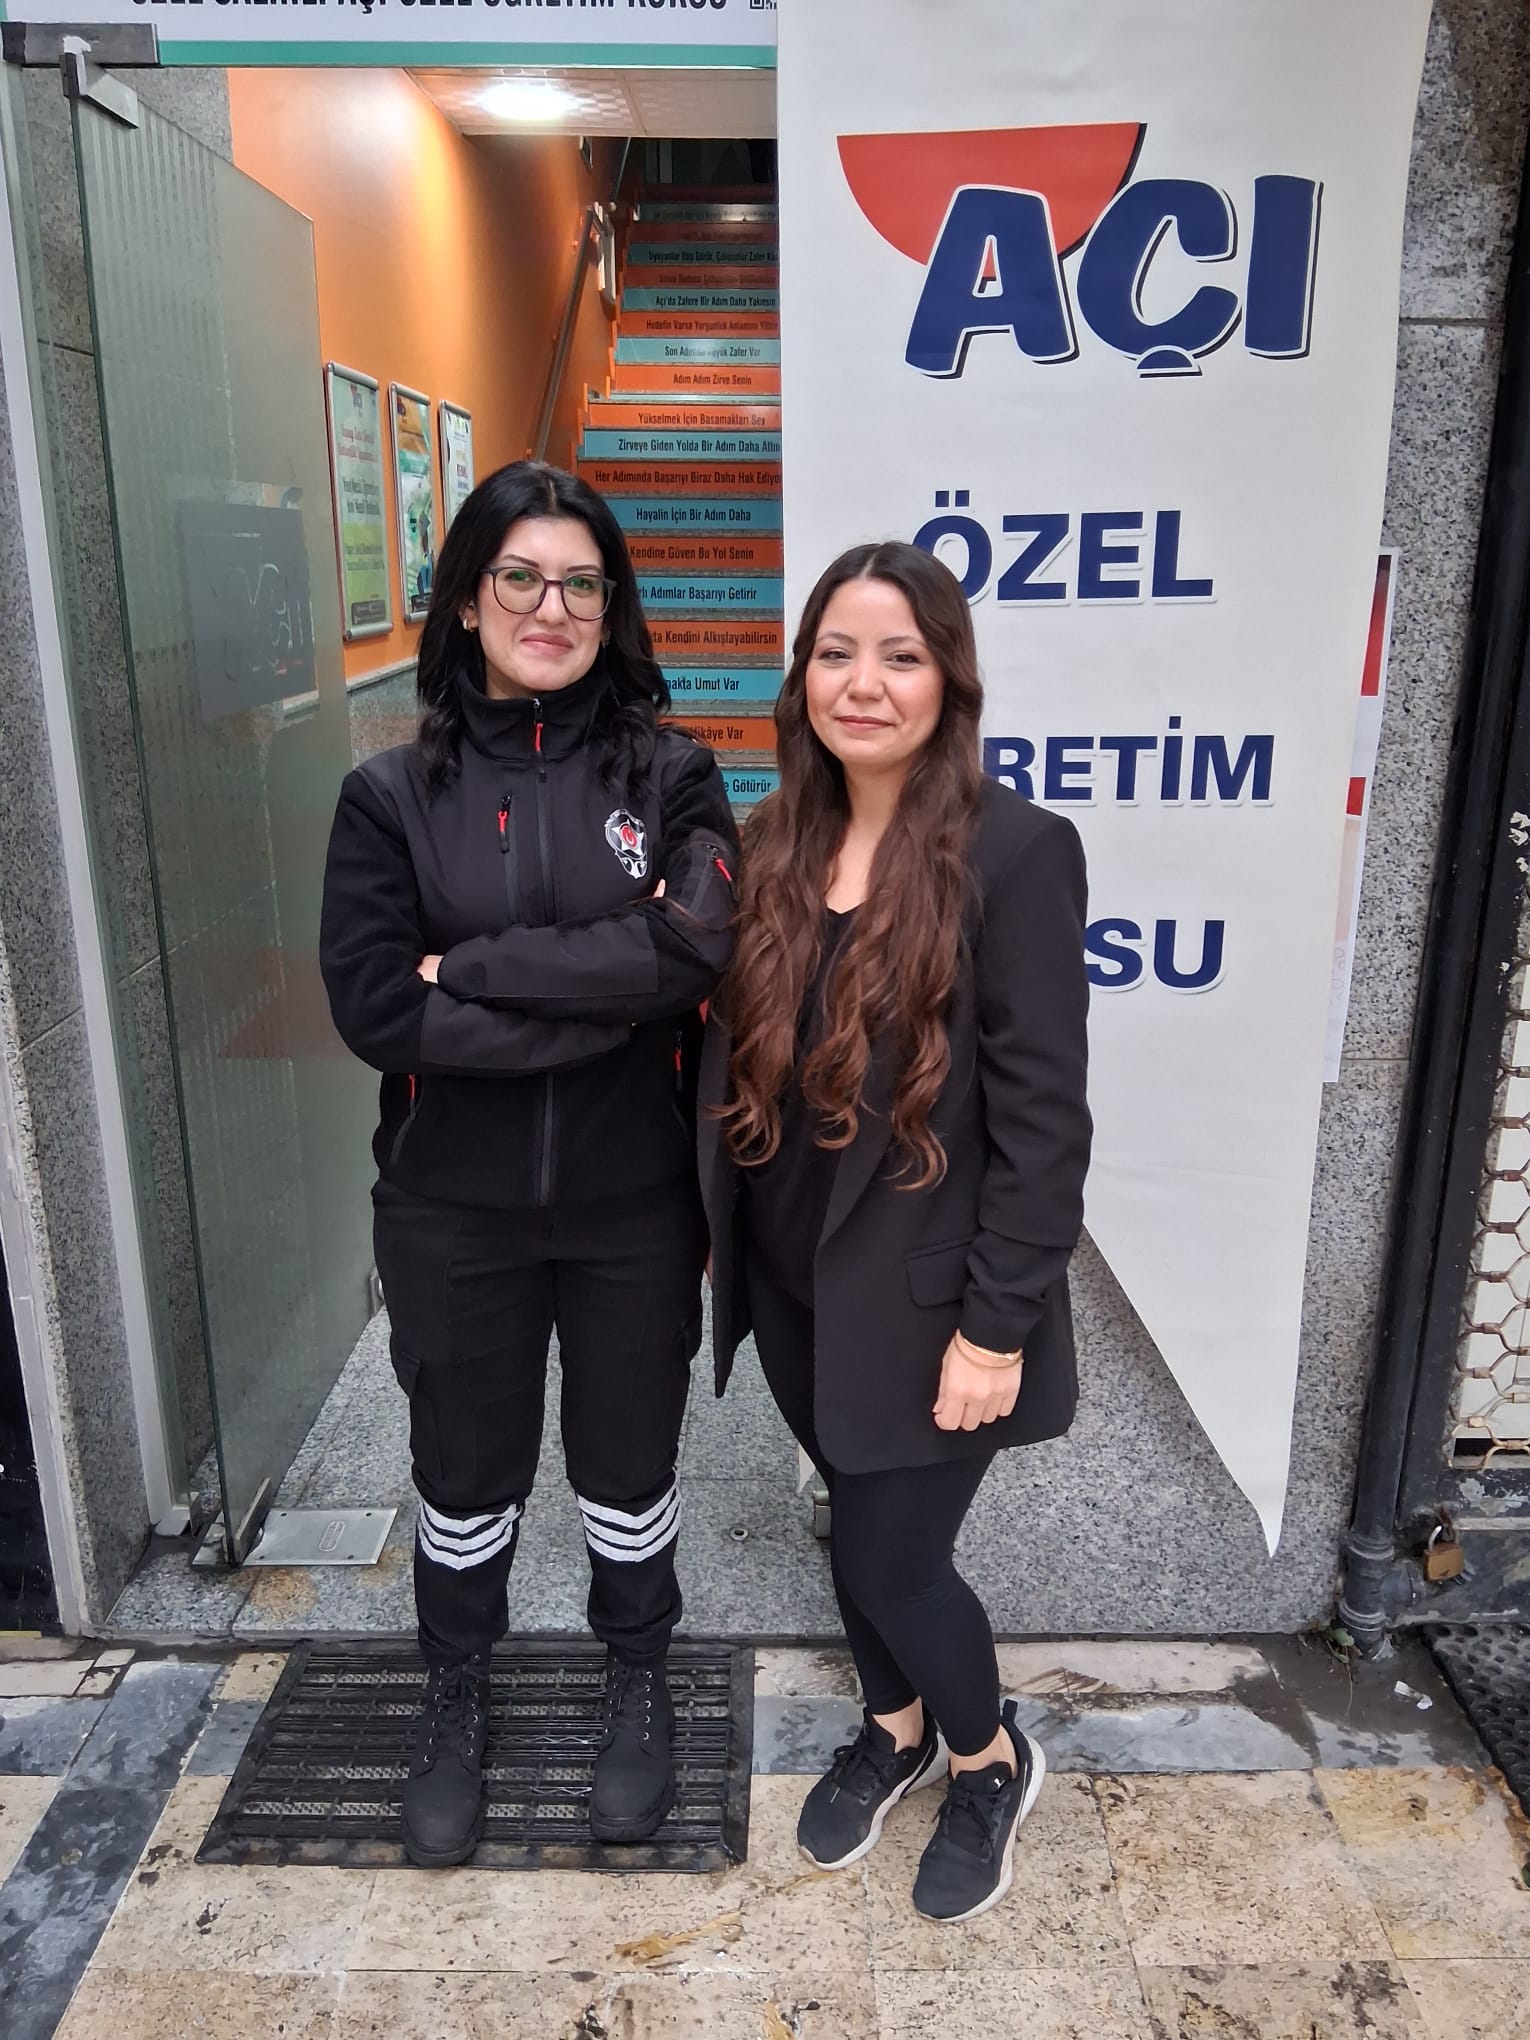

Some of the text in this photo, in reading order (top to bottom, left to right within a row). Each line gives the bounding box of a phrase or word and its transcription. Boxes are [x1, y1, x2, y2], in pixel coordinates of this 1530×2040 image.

[904, 174, 1323, 379] AÇI
[700, 295, 710, 306] Bir
[711, 296, 729, 306] Adım
[730, 296, 747, 307] Daha
[664, 346, 678, 357] Son
[729, 346, 747, 357] Zafer
[749, 347, 761, 357] Var
[672, 374, 752, 385] Adım Adım Zirve Senin
[638, 412, 681, 425] Yükselmek
[683, 411, 698, 426] İçin
[700, 413, 749, 425] Basamakları
[618, 439, 648, 453] Zirveye
[650, 439, 674, 451] Giden
[676, 439, 699, 452] Yolda
[701, 440, 713, 452] Bir
[715, 440, 737, 453] Adım
[738, 440, 760, 453] Daha
[595, 470, 610, 482] Her
[612, 470, 651, 483] Adımında
[654, 471, 689, 486] Başarıyı
[690, 471, 712, 484] Biraz
[714, 472, 736, 485] Daha
[738, 472, 754, 485] Hak
[635, 506, 751, 524] Hayalin İçin Bir Adım Daha
[630, 545, 754, 560] Kendine Güven Bu Yol Senin
[911, 489, 1215, 603] ÖZEL
[650, 586, 686, 600] Adımlar
[688, 587, 726, 602] Başarıyı
[728, 587, 758, 600] Getirir
[665, 630, 700, 644] Kendini
[703, 630, 777, 646] Alkışlayabilirsin
[694, 676, 721, 691] Umut
[723, 677, 740, 691] Var
[726, 726, 744, 740] Var
[983, 715, 1275, 801] RETİM
[732, 778, 771, 793] Götürür
